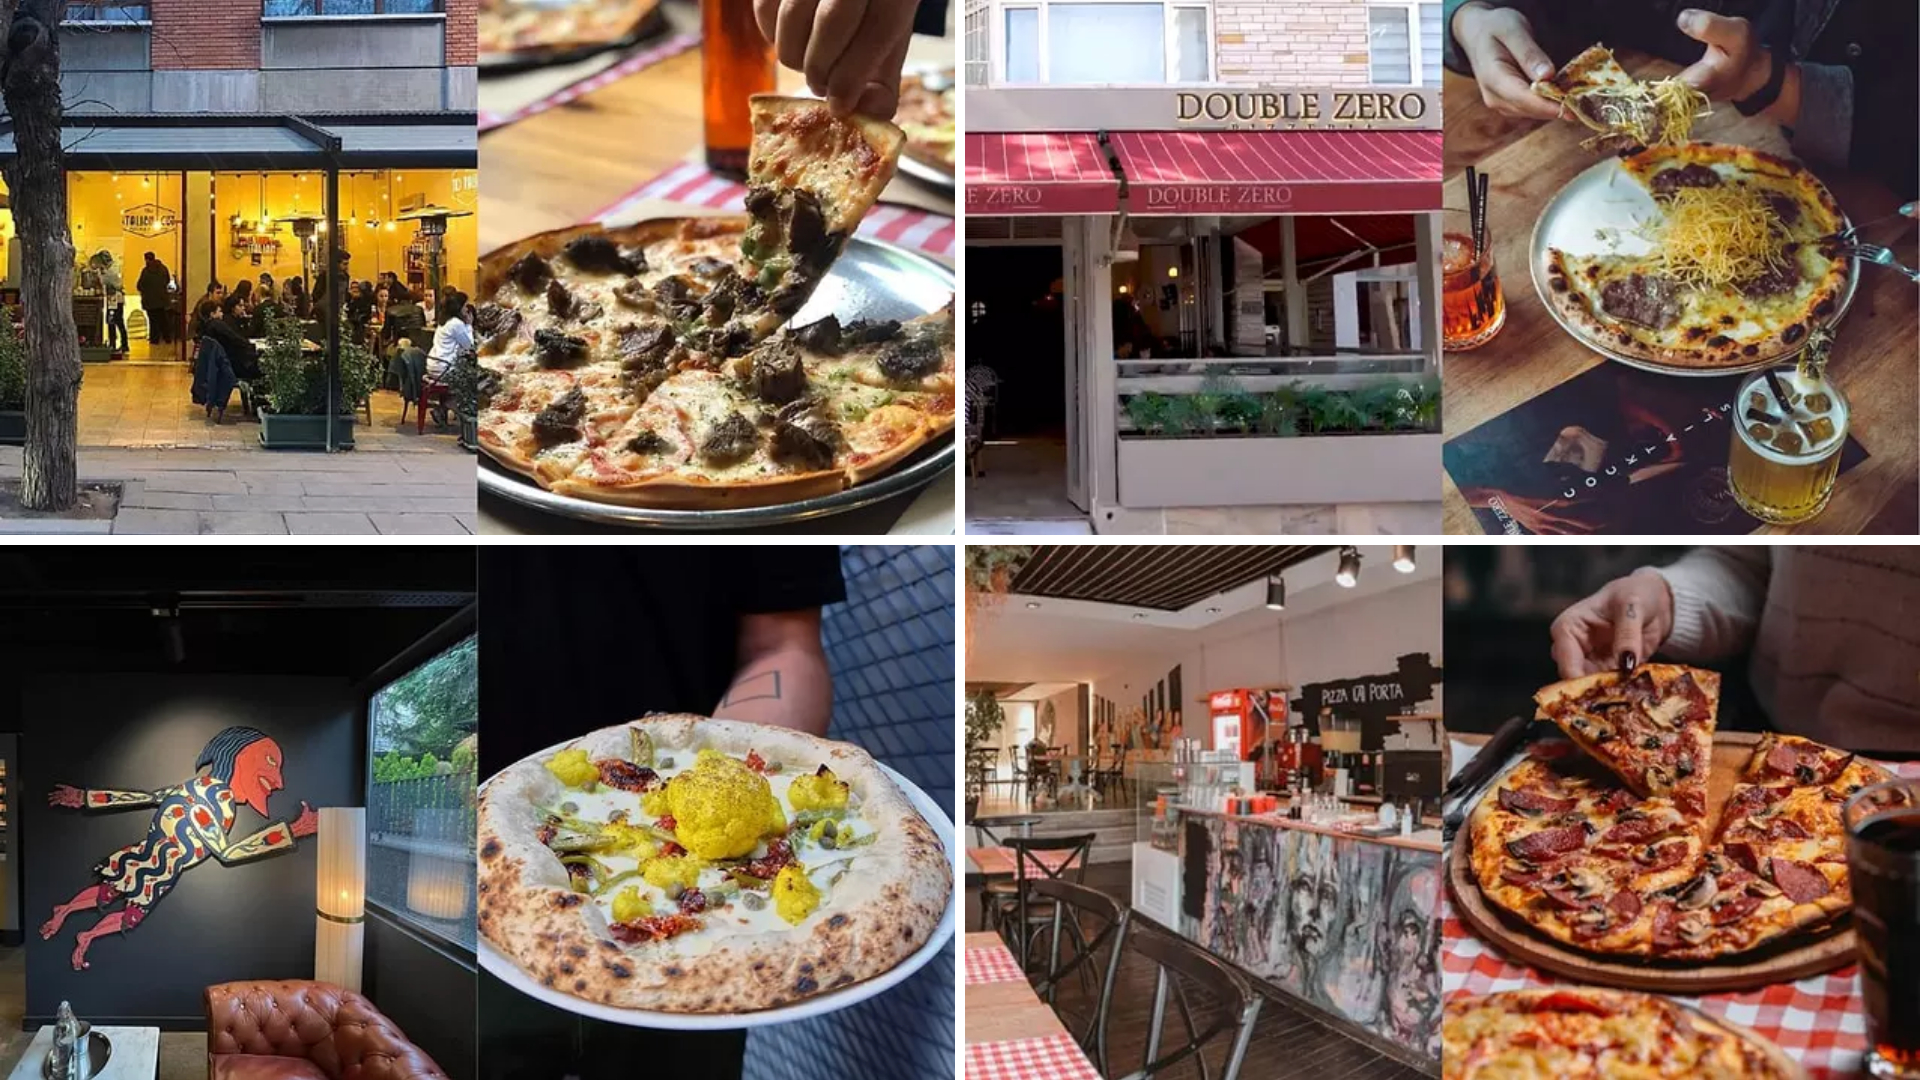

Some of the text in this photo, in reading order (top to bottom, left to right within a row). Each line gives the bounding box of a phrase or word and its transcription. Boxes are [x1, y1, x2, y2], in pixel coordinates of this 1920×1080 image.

[1176, 92, 1426, 120] DOUBLE ZERO
[985, 186, 1042, 204] ZERO
[1147, 187, 1292, 204] DOUBLE ZERO
[1564, 403, 1731, 499] COCKTAILS
[1321, 688, 1348, 706] PIZZA
[1369, 683, 1404, 702] PORTA
